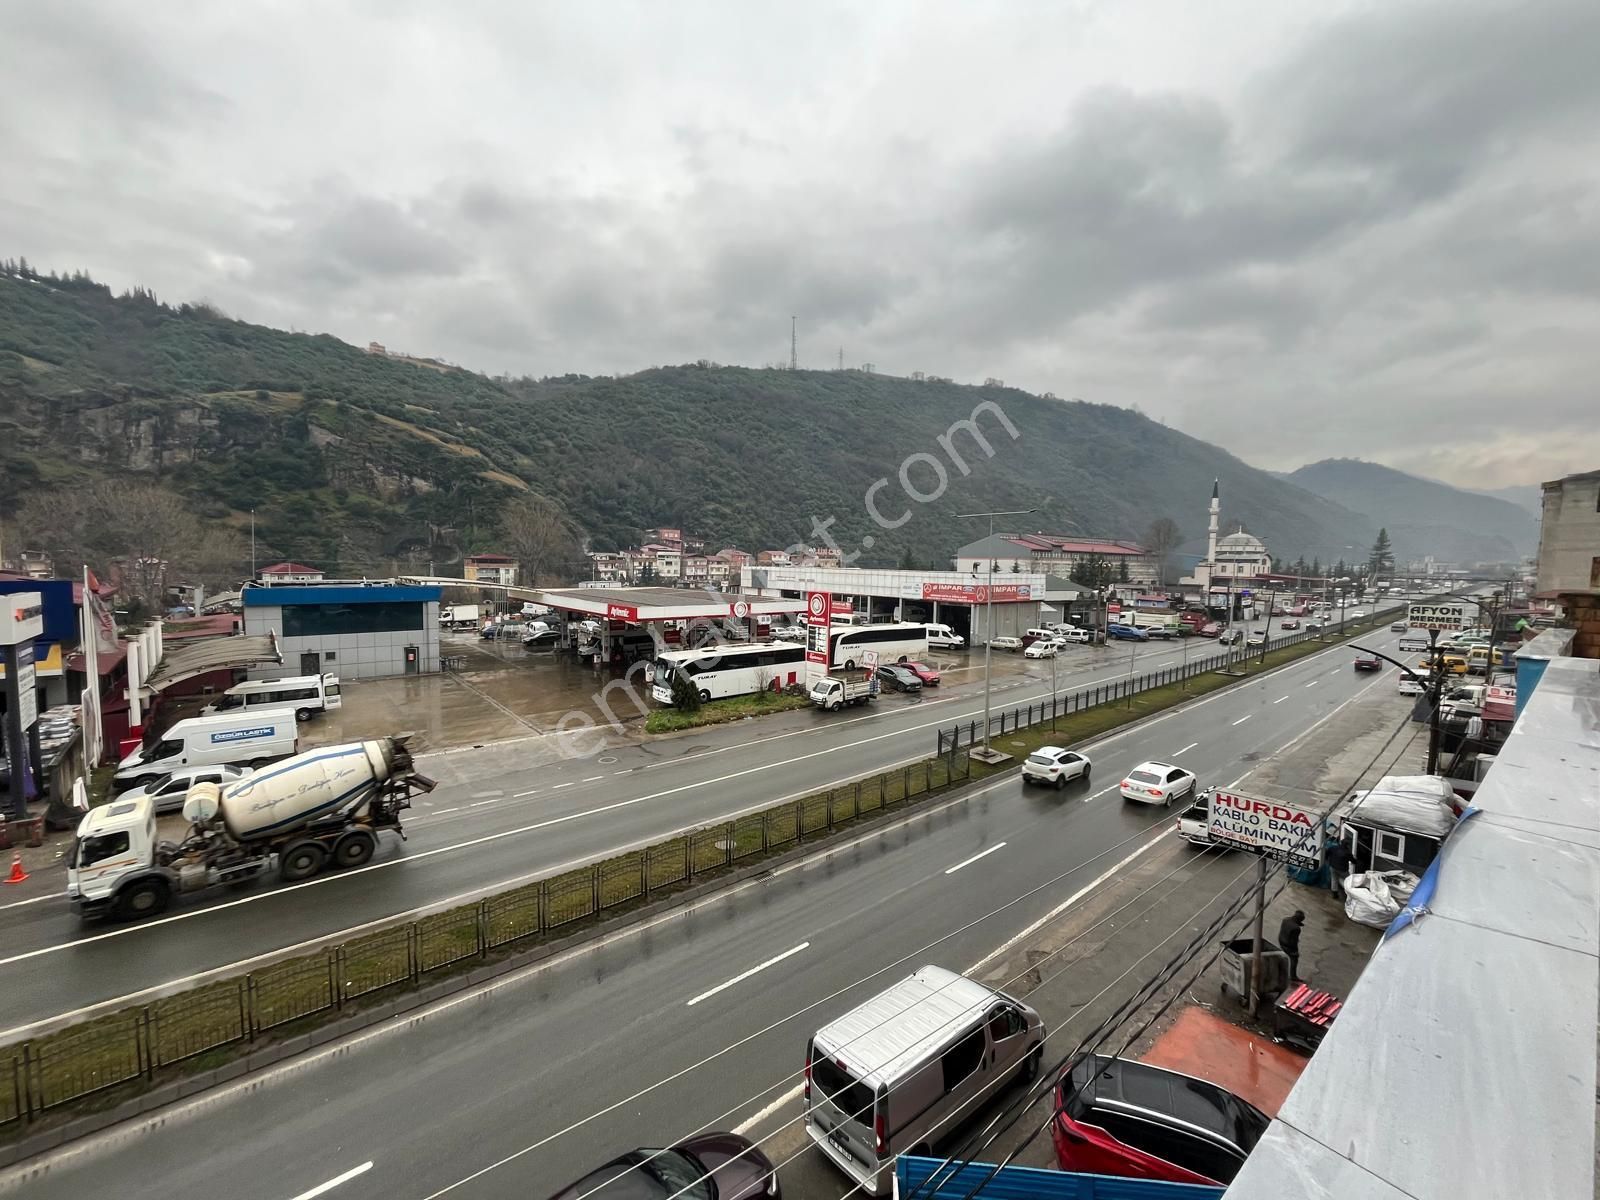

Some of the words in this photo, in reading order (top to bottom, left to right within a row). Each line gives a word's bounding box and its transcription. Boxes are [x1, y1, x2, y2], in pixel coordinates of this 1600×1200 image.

[1410, 606, 1463, 615] AFYON
[1410, 615, 1461, 624] MERMER
[1213, 805, 1260, 825] KABLO
[1268, 819, 1316, 840] BAKIR
[1216, 793, 1313, 827] HURDA
[1212, 819, 1317, 854] ALÜMİNYUM
